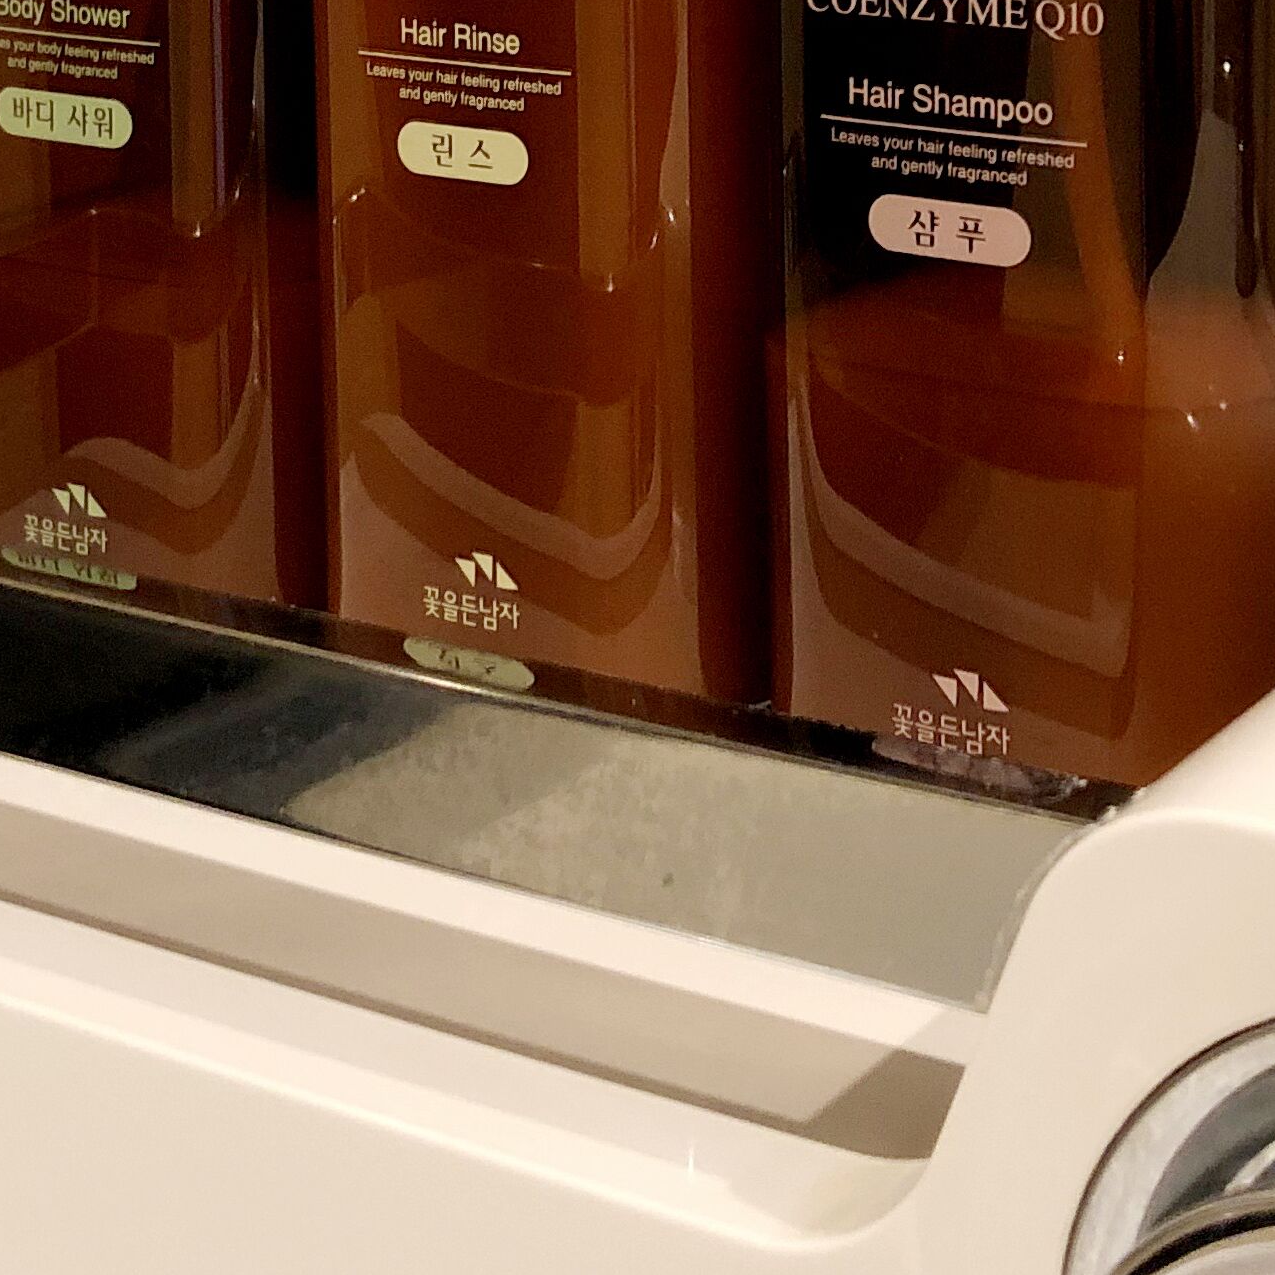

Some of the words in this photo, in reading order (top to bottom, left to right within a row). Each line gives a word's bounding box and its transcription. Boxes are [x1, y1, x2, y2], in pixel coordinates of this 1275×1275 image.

[13, 39, 35, 53] your
[37, 40, 62, 58] body
[65, 44, 99, 62] feeling
[102, 48, 155, 65] refreshed
[400, 17, 447, 48] Hair
[454, 23, 520, 55] Rinse
[8, 56, 26, 69] and
[28, 58, 58, 75] gently
[61, 61, 118, 79] fragranced
[366, 61, 406, 80] Leaves
[408, 68, 433, 84] your
[436, 69, 458, 85] hair
[461, 71, 500, 92] feeling
[503, 76, 562, 96] refreshed
[12, 96, 54, 133] 바디
[67, 104, 113, 140] 샤워
[399, 86, 420, 101] and
[423, 89, 458, 107] gently
[461, 92, 525, 112] fragranced
[848, 76, 904, 110] Hair
[912, 83, 1053, 128] Shampoo
[831, 126, 880, 148] Leaves
[883, 136, 914, 152] your
[918, 137, 943, 155] hair
[948, 140, 997, 165] feeling
[1001, 148, 1075, 170] refreshed
[871, 154, 898, 171] and
[901, 158, 943, 179] gently
[947, 162, 1028, 187] fragranced
[23, 513, 108, 556] 꽃을든남자
[422, 585, 520, 632] 꽃을든남자
[892, 702, 1011, 756] 꽃을든남자
